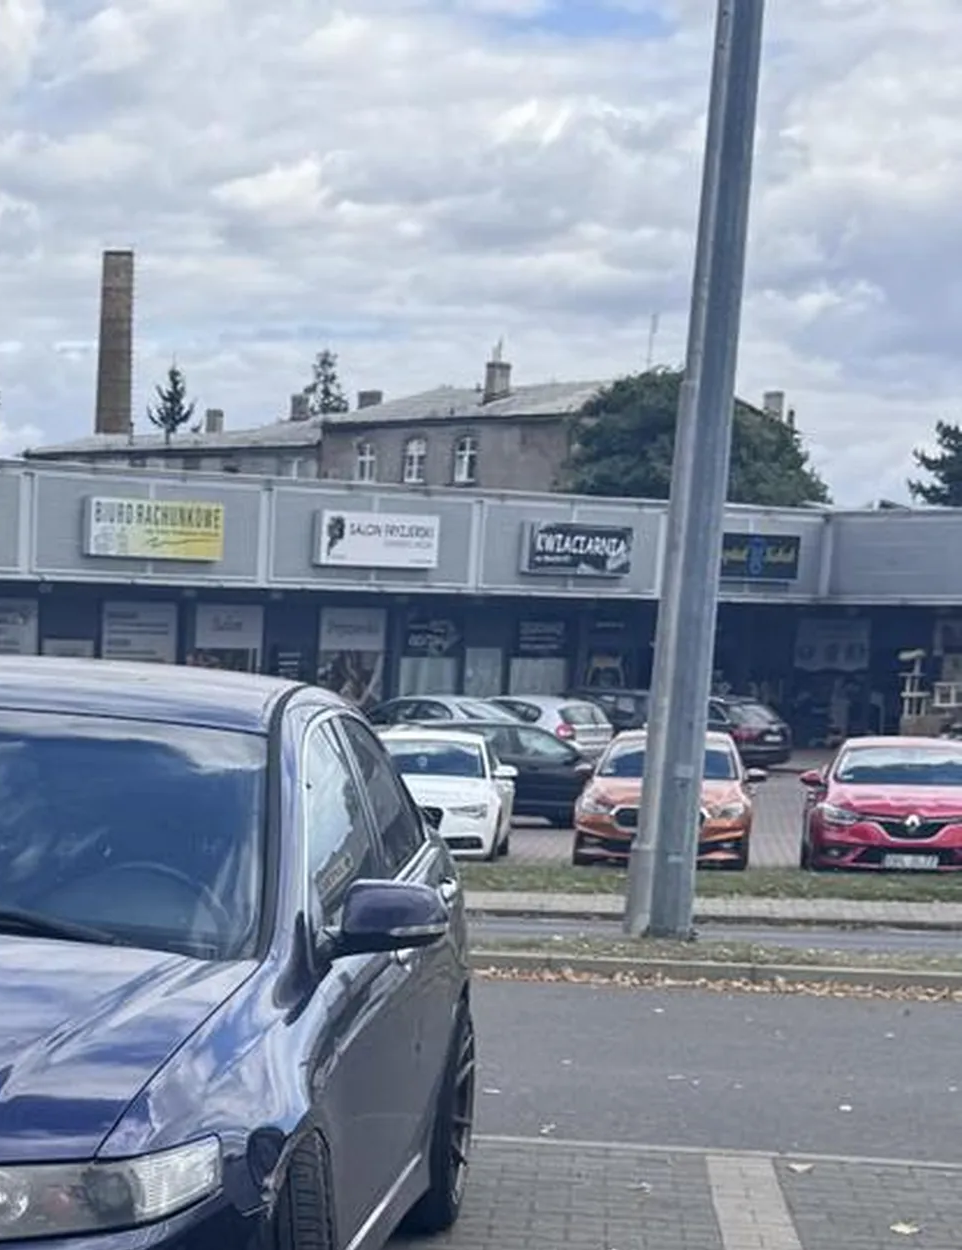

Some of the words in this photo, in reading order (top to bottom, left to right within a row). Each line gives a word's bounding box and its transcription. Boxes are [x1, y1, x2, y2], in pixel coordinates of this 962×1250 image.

[95, 501, 134, 525] BIURO
[136, 503, 222, 529] RACHUNKOWE
[349, 523, 382, 537] SALON
[536, 533, 628, 556] KWIACIARNIA
